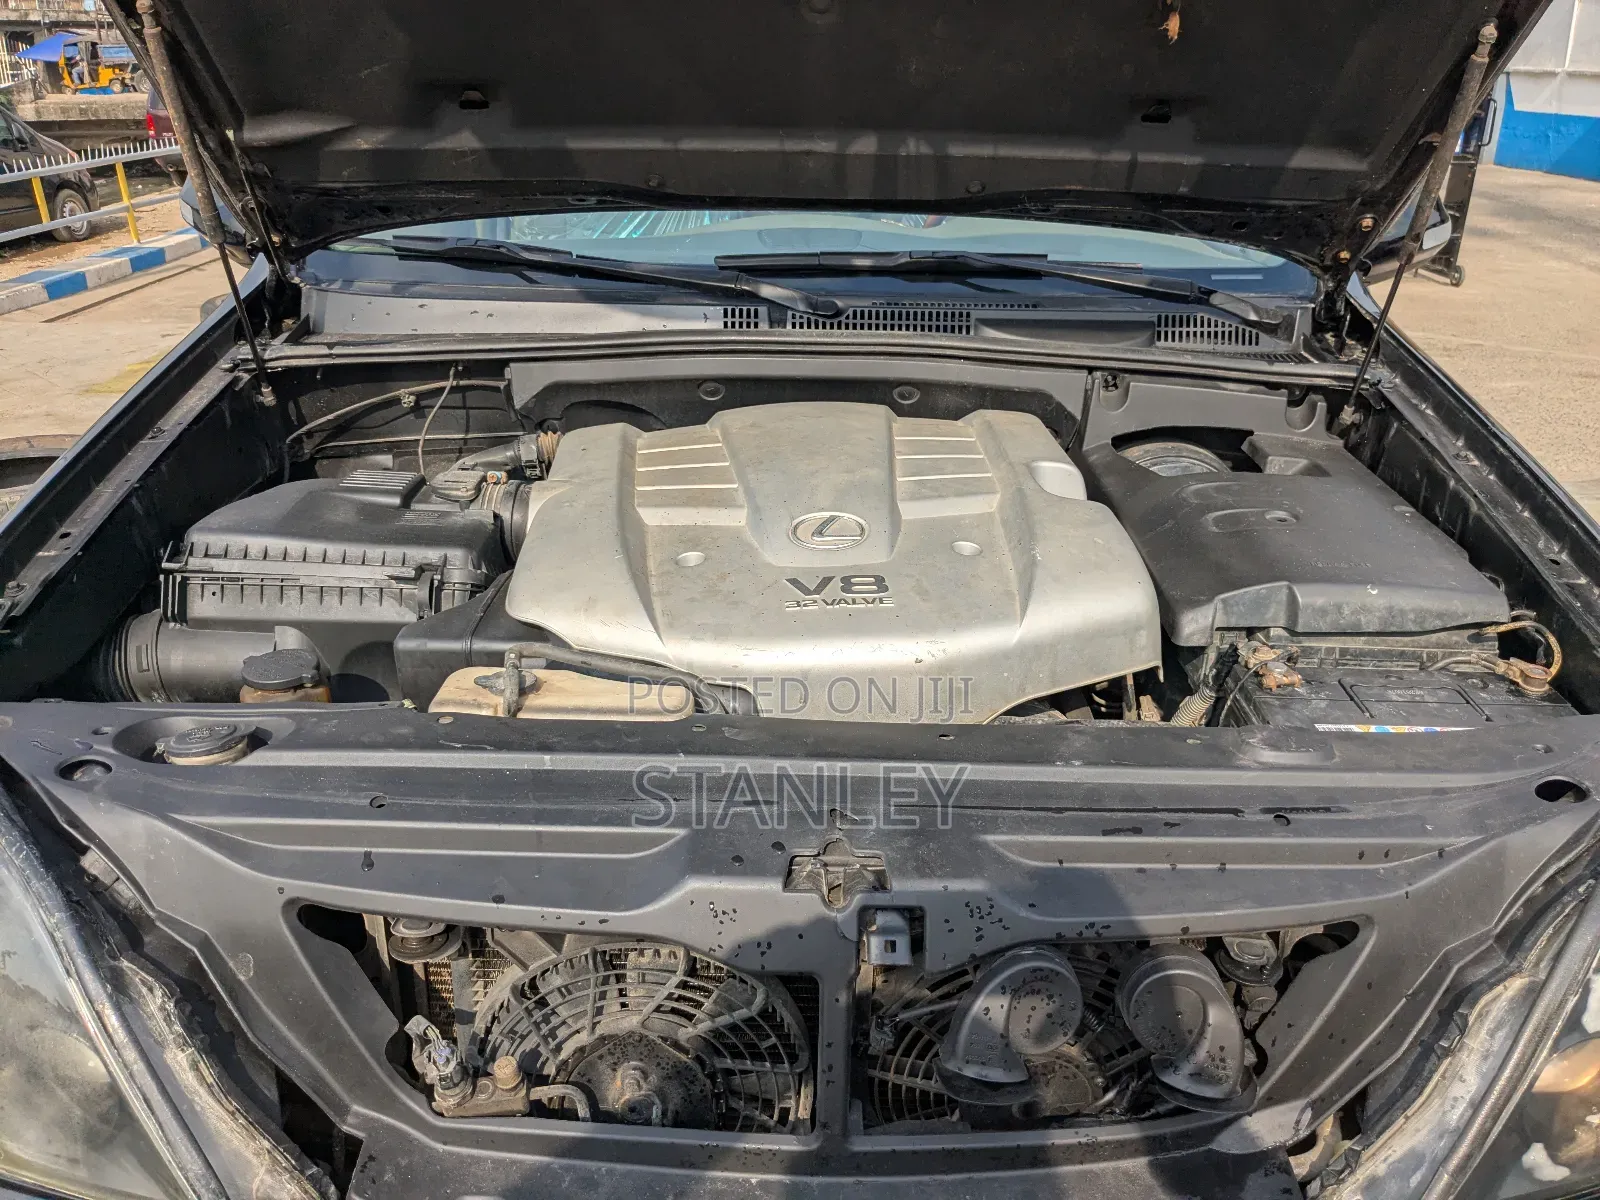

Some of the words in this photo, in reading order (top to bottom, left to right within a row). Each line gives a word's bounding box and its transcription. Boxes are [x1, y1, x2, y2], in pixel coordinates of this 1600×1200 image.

[784, 574, 890, 597] V8
[784, 600, 819, 610] 32
[820, 597, 895, 608] VALVE
